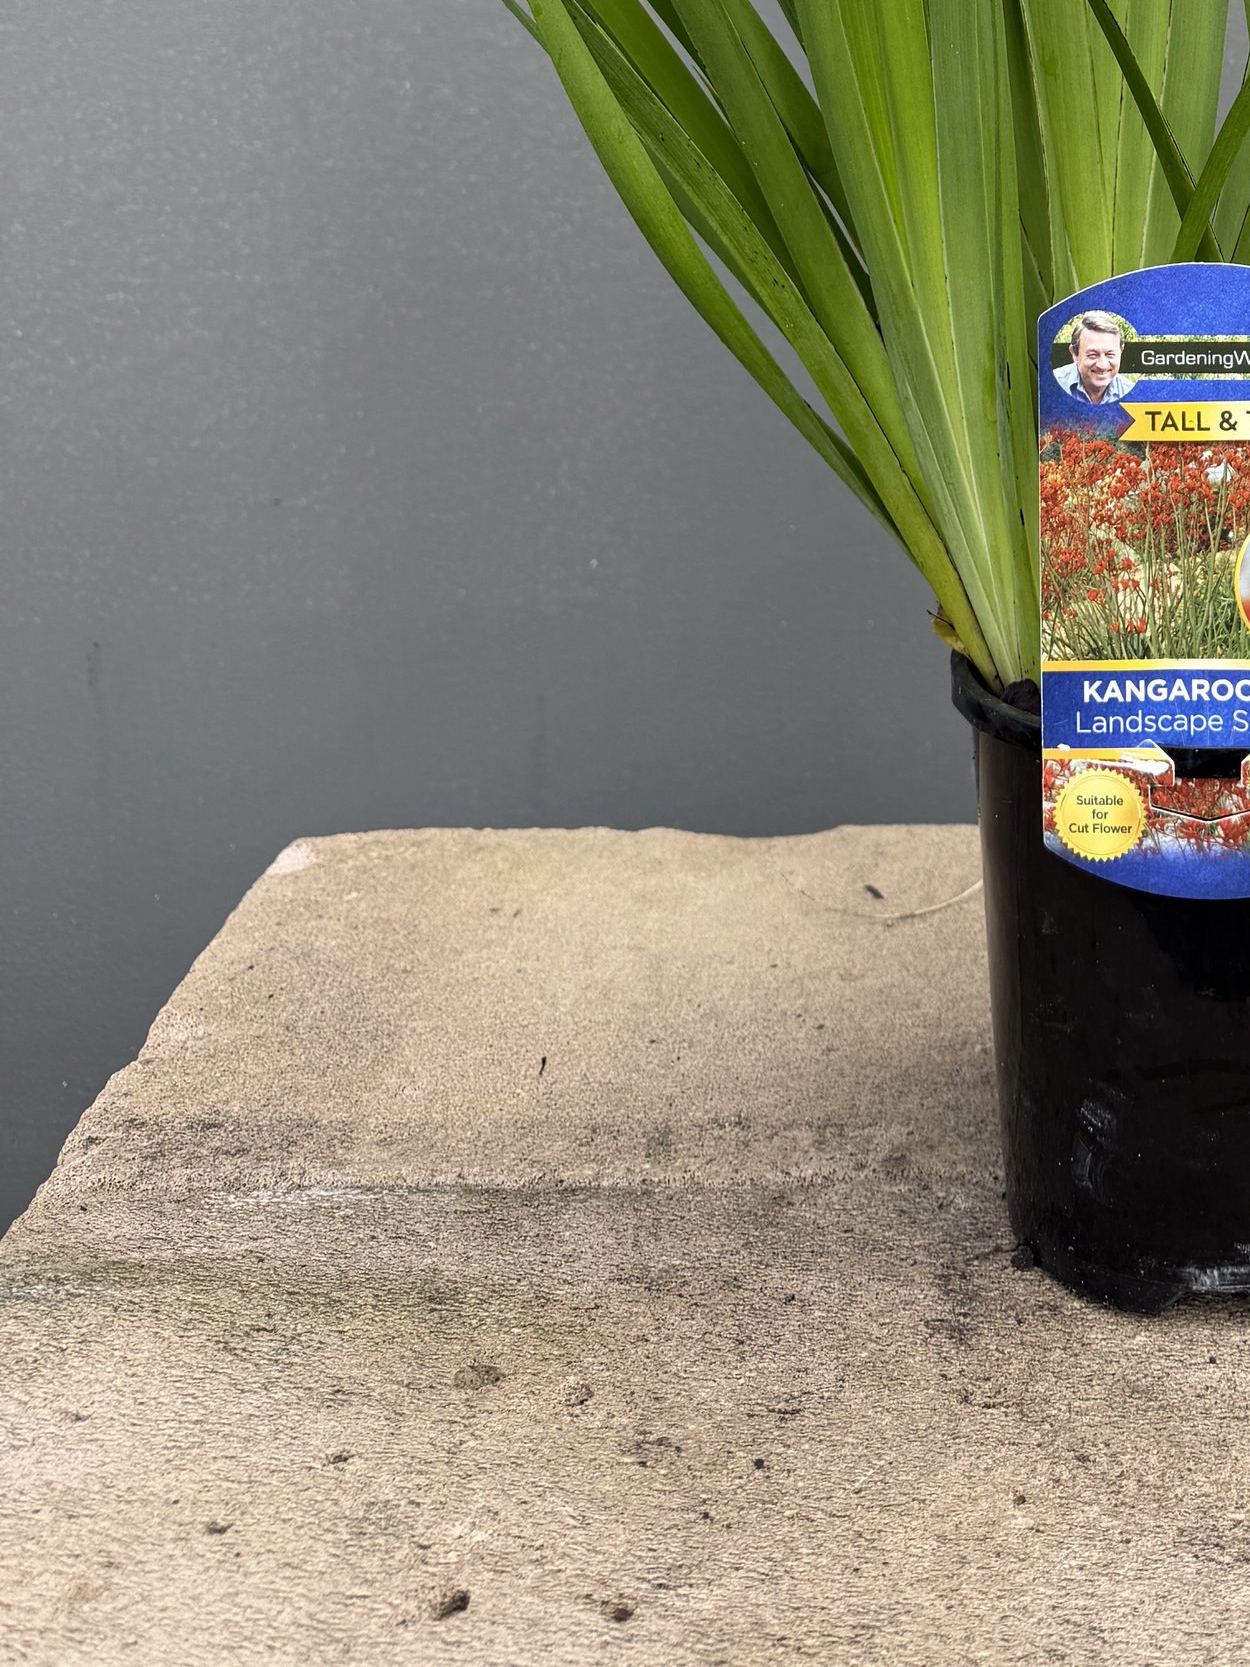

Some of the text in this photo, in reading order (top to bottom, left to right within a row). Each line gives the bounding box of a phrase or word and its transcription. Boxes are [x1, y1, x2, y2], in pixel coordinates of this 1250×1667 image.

[1145, 410, 1210, 432] TALL
[1219, 410, 1238, 432] &
[1076, 709, 1224, 736] Landscape
[1076, 795, 1124, 806] Suitable
[1092, 809, 1109, 820] for
[1068, 822, 1132, 834] Cut Flower
